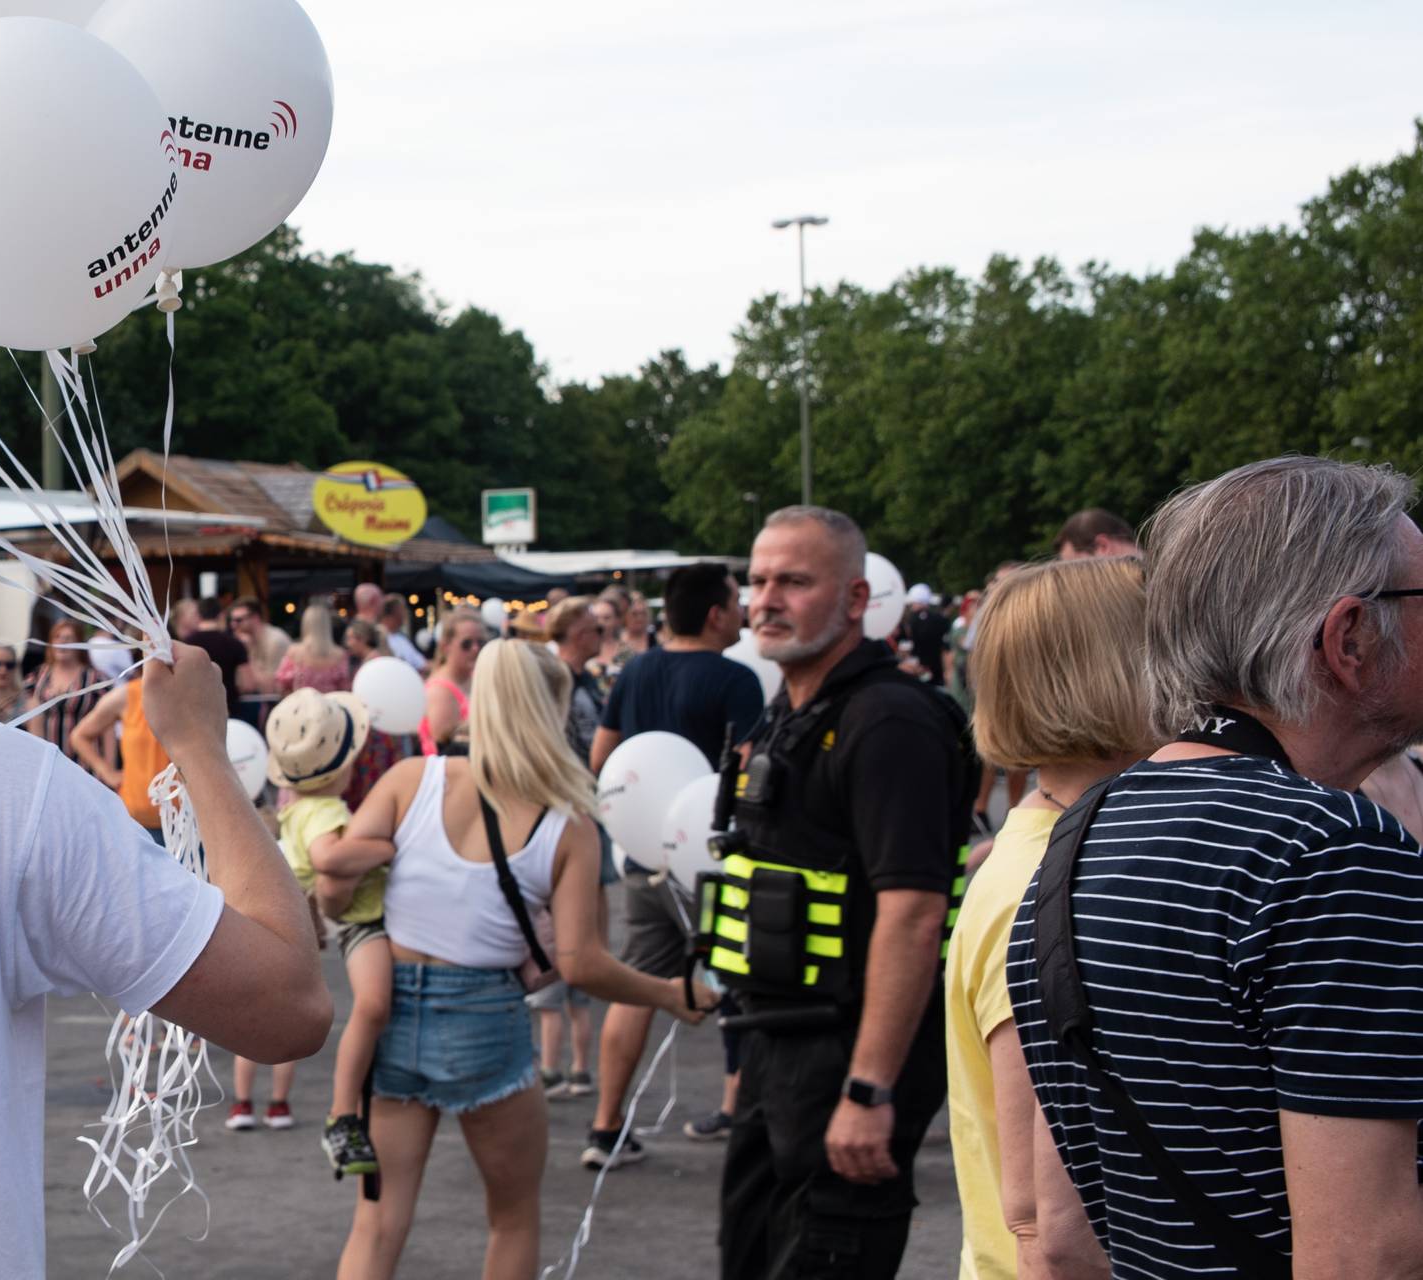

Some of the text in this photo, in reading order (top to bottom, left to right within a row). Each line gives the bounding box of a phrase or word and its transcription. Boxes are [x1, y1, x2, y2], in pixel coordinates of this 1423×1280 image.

[167, 115, 271, 150] tenne
[86, 171, 178, 279] antenne
[93, 237, 161, 299] unna
[1180, 712, 1237, 735] NY
